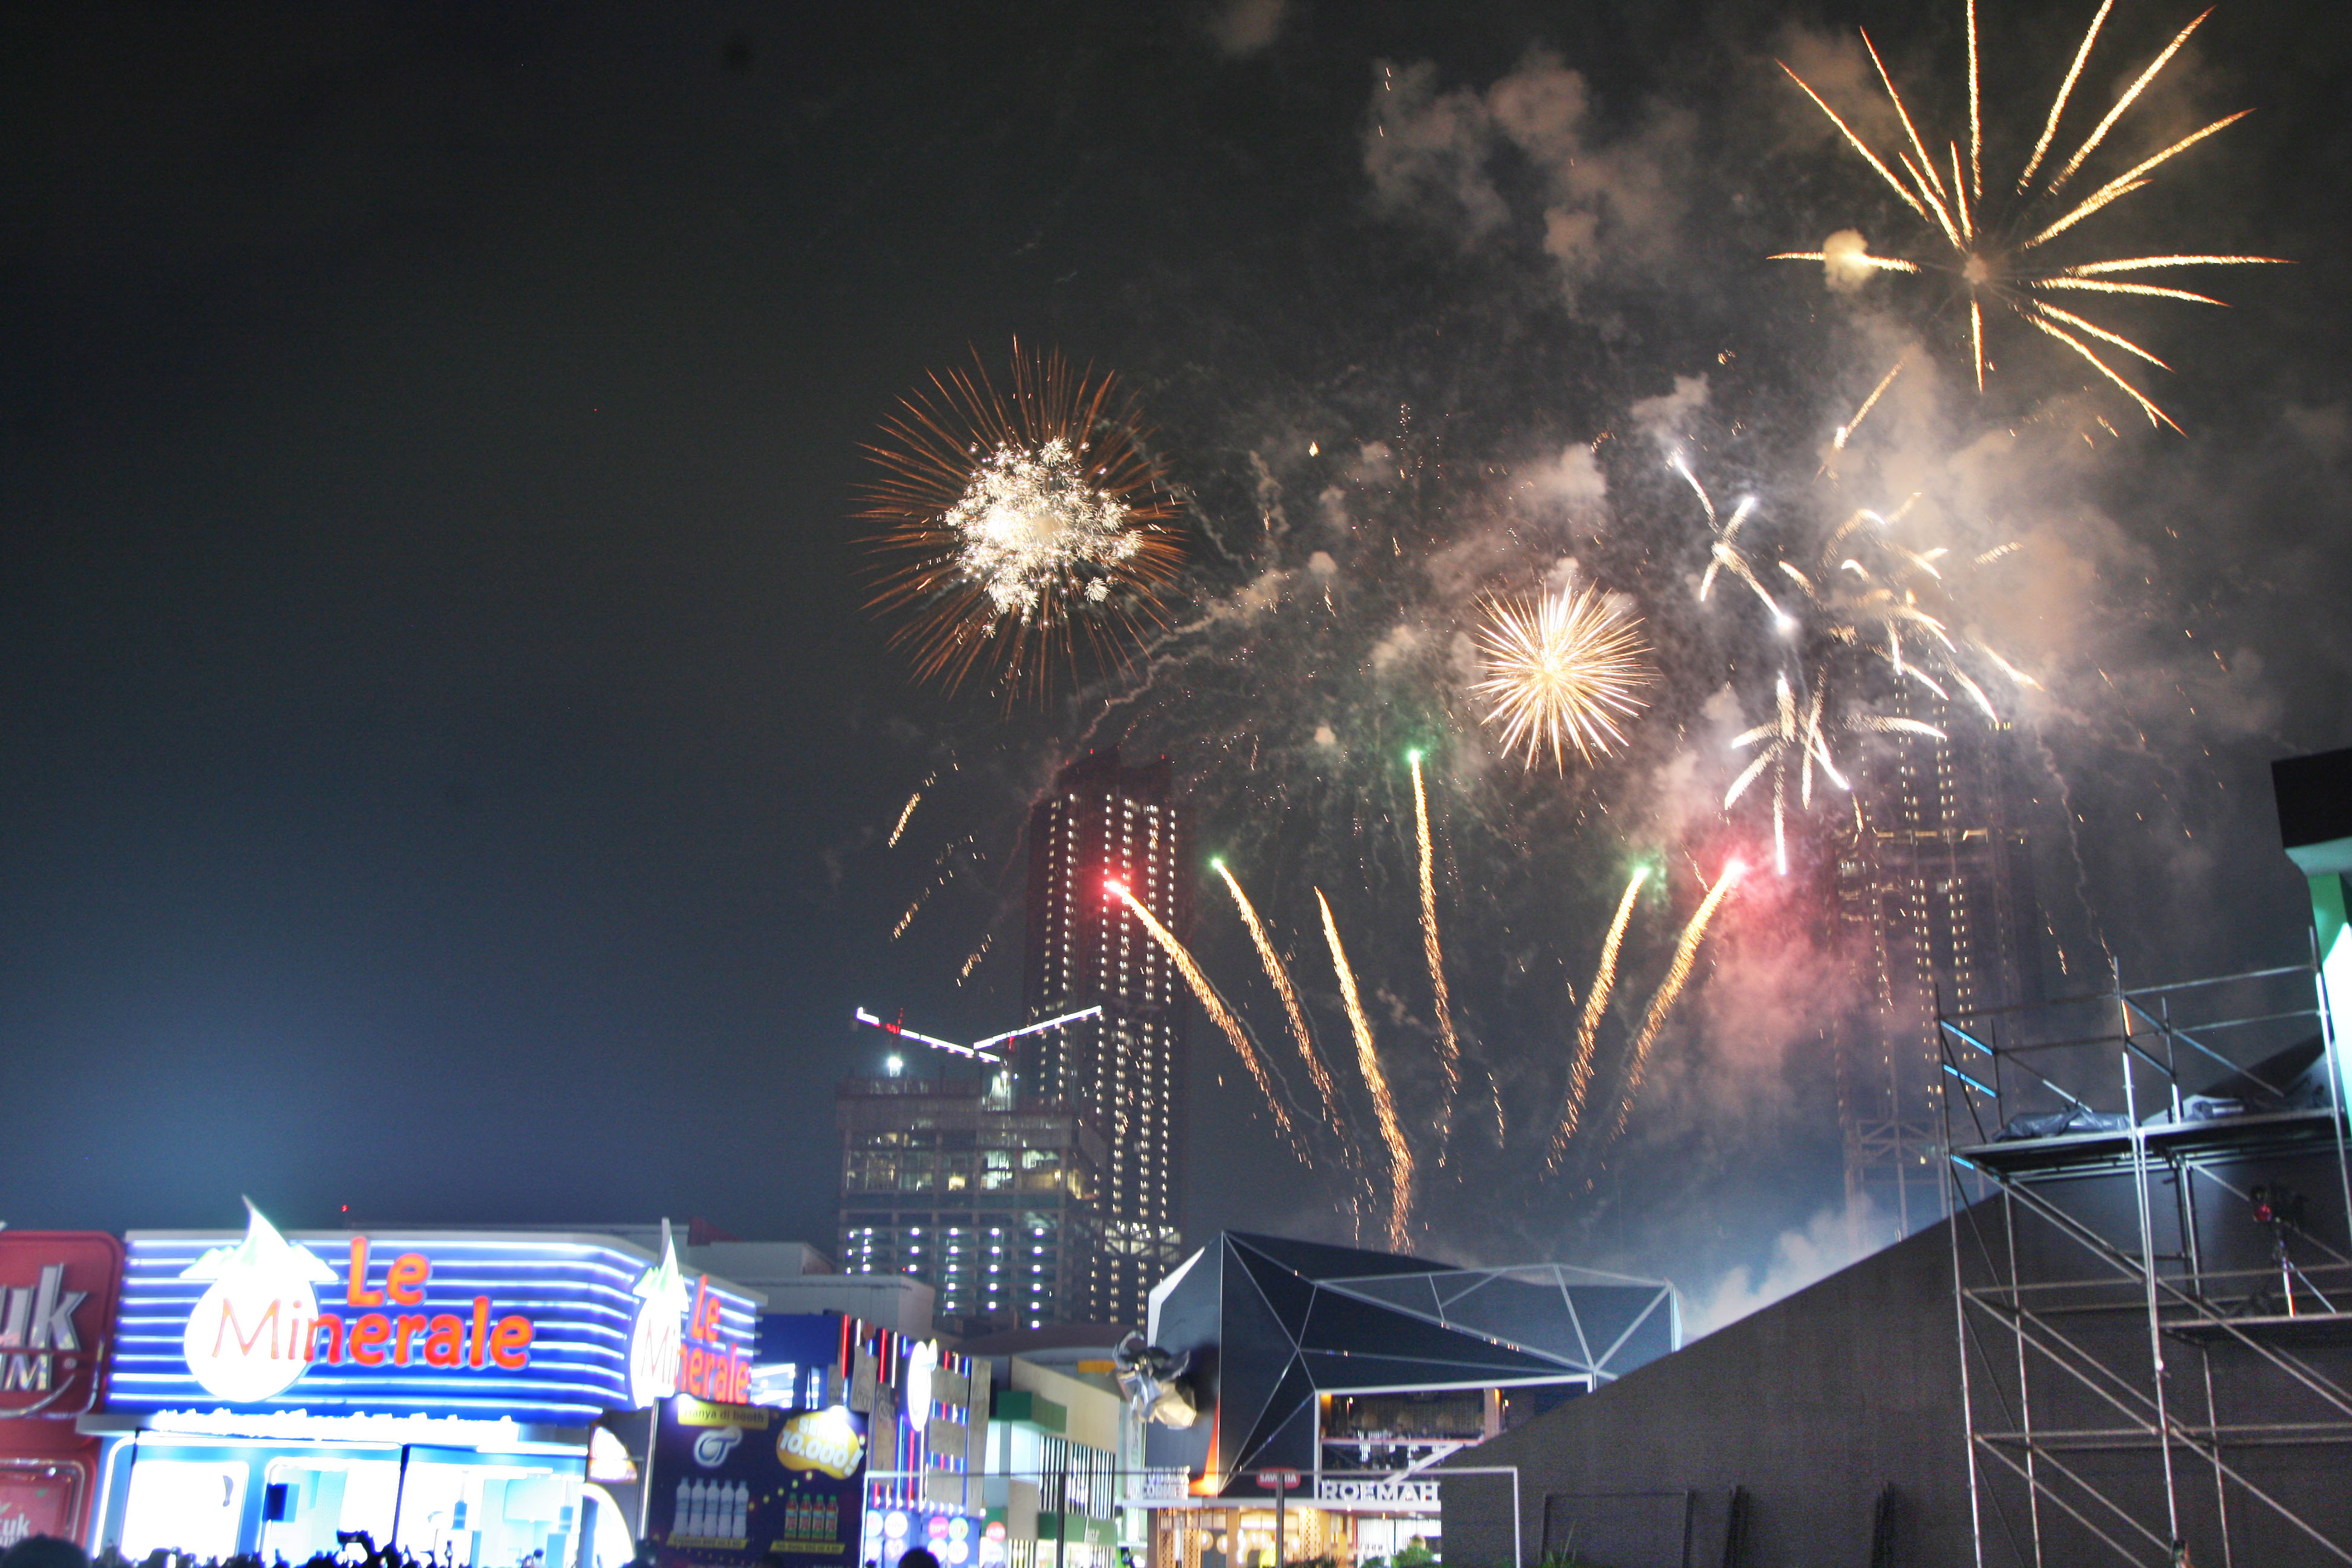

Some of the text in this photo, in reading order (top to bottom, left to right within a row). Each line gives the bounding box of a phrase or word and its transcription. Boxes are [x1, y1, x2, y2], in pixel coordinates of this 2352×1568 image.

[347, 1236, 430, 1307] Le
[212, 1296, 534, 1369] Minerale
[691, 1274, 721, 1344] Le
[641, 1319, 751, 1405] Minerale
[733, 1409, 764, 1423] booth
[779, 1429, 864, 1477] 10.000!
[1321, 1480, 1438, 1501] ROEMAH
